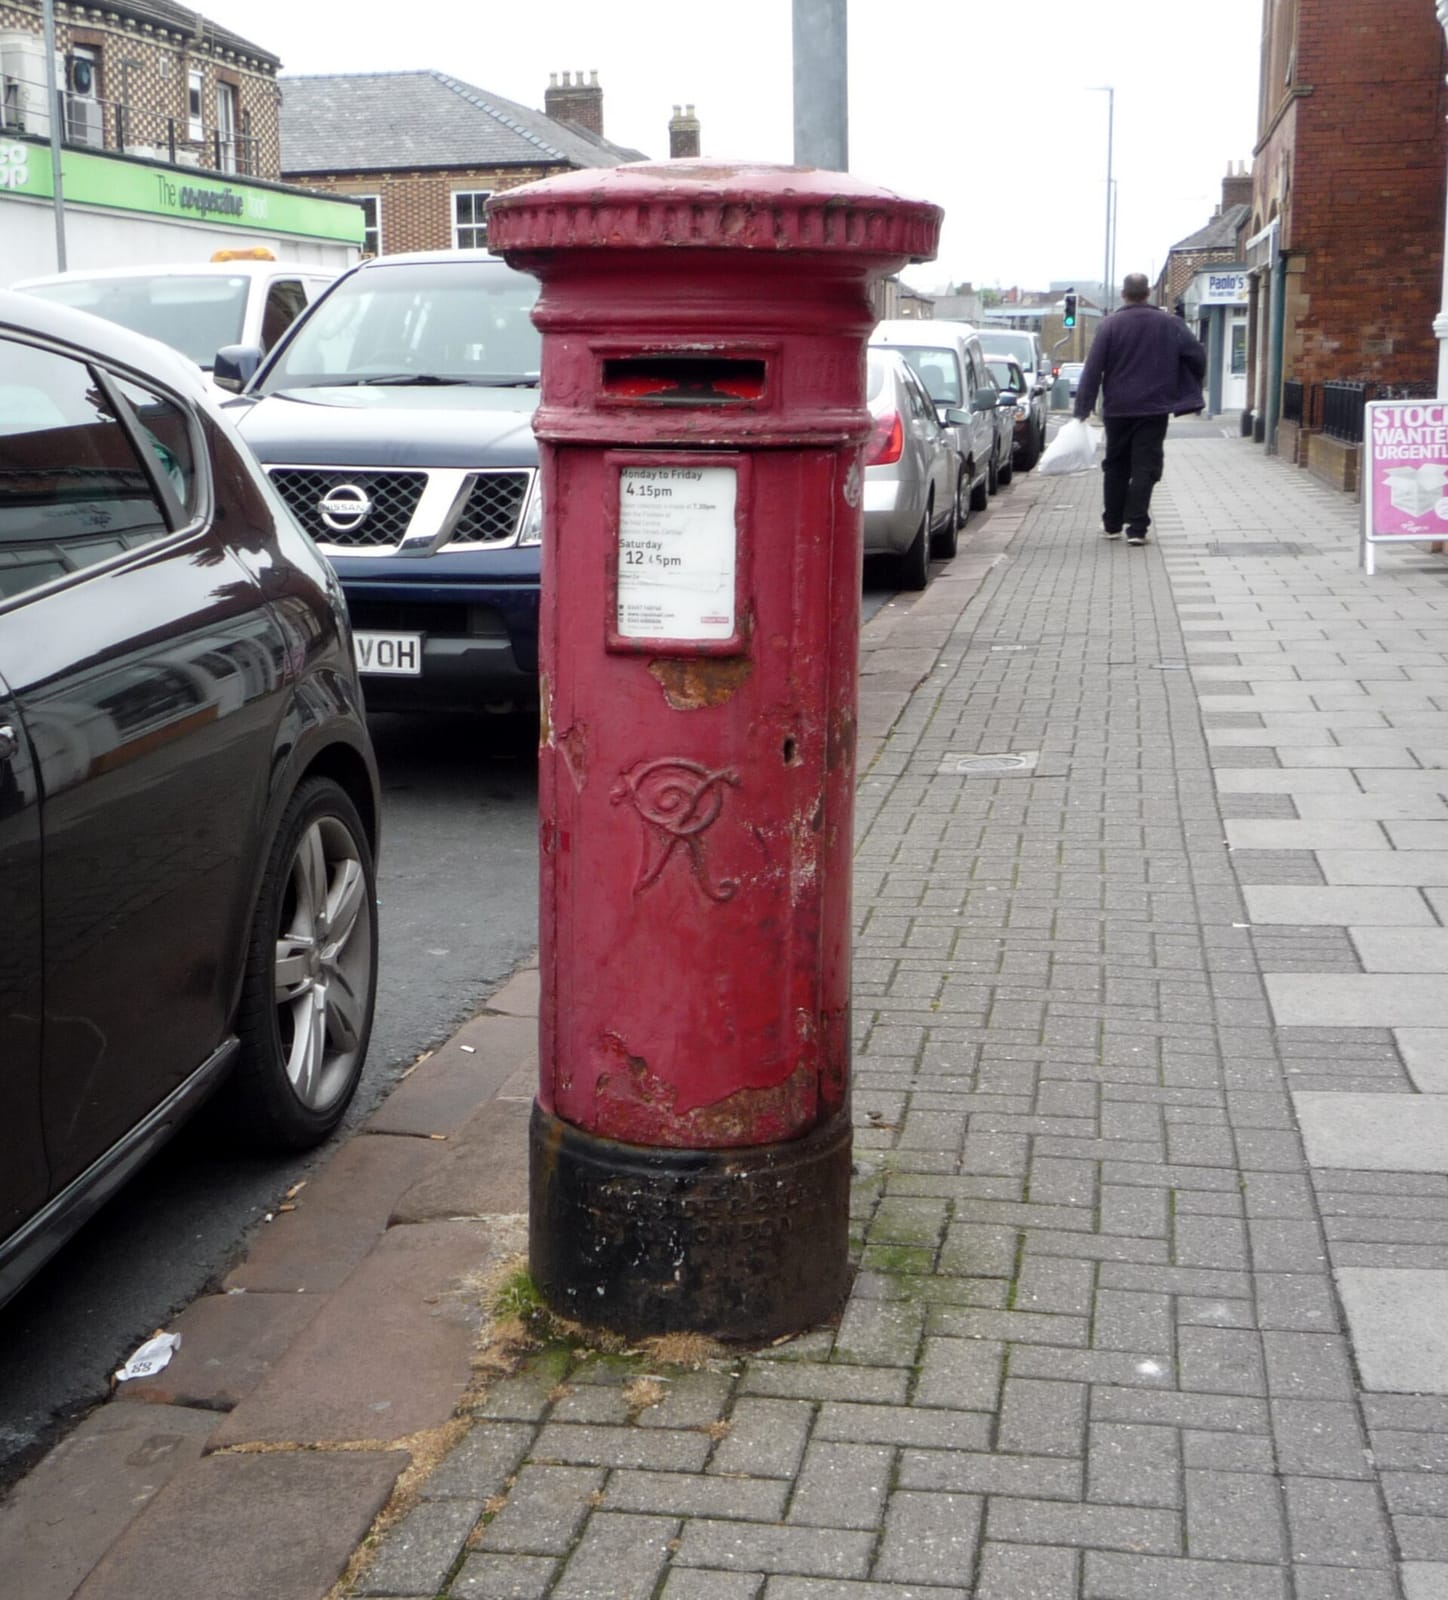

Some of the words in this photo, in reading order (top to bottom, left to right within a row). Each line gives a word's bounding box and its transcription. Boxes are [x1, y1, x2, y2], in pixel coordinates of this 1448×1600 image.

[155, 174, 176, 207] The
[180, 187, 243, 217] co-operative
[1209, 274, 1244, 290] Paolo's
[1373, 406, 1448, 428] STOC
[621, 470, 657, 480] Monday
[659, 470, 669, 479] to
[671, 470, 703, 481] Friday
[323, 502, 366, 512] NISSAN
[619, 538, 663, 550] Saturday
[357, 639, 415, 669] VOH
